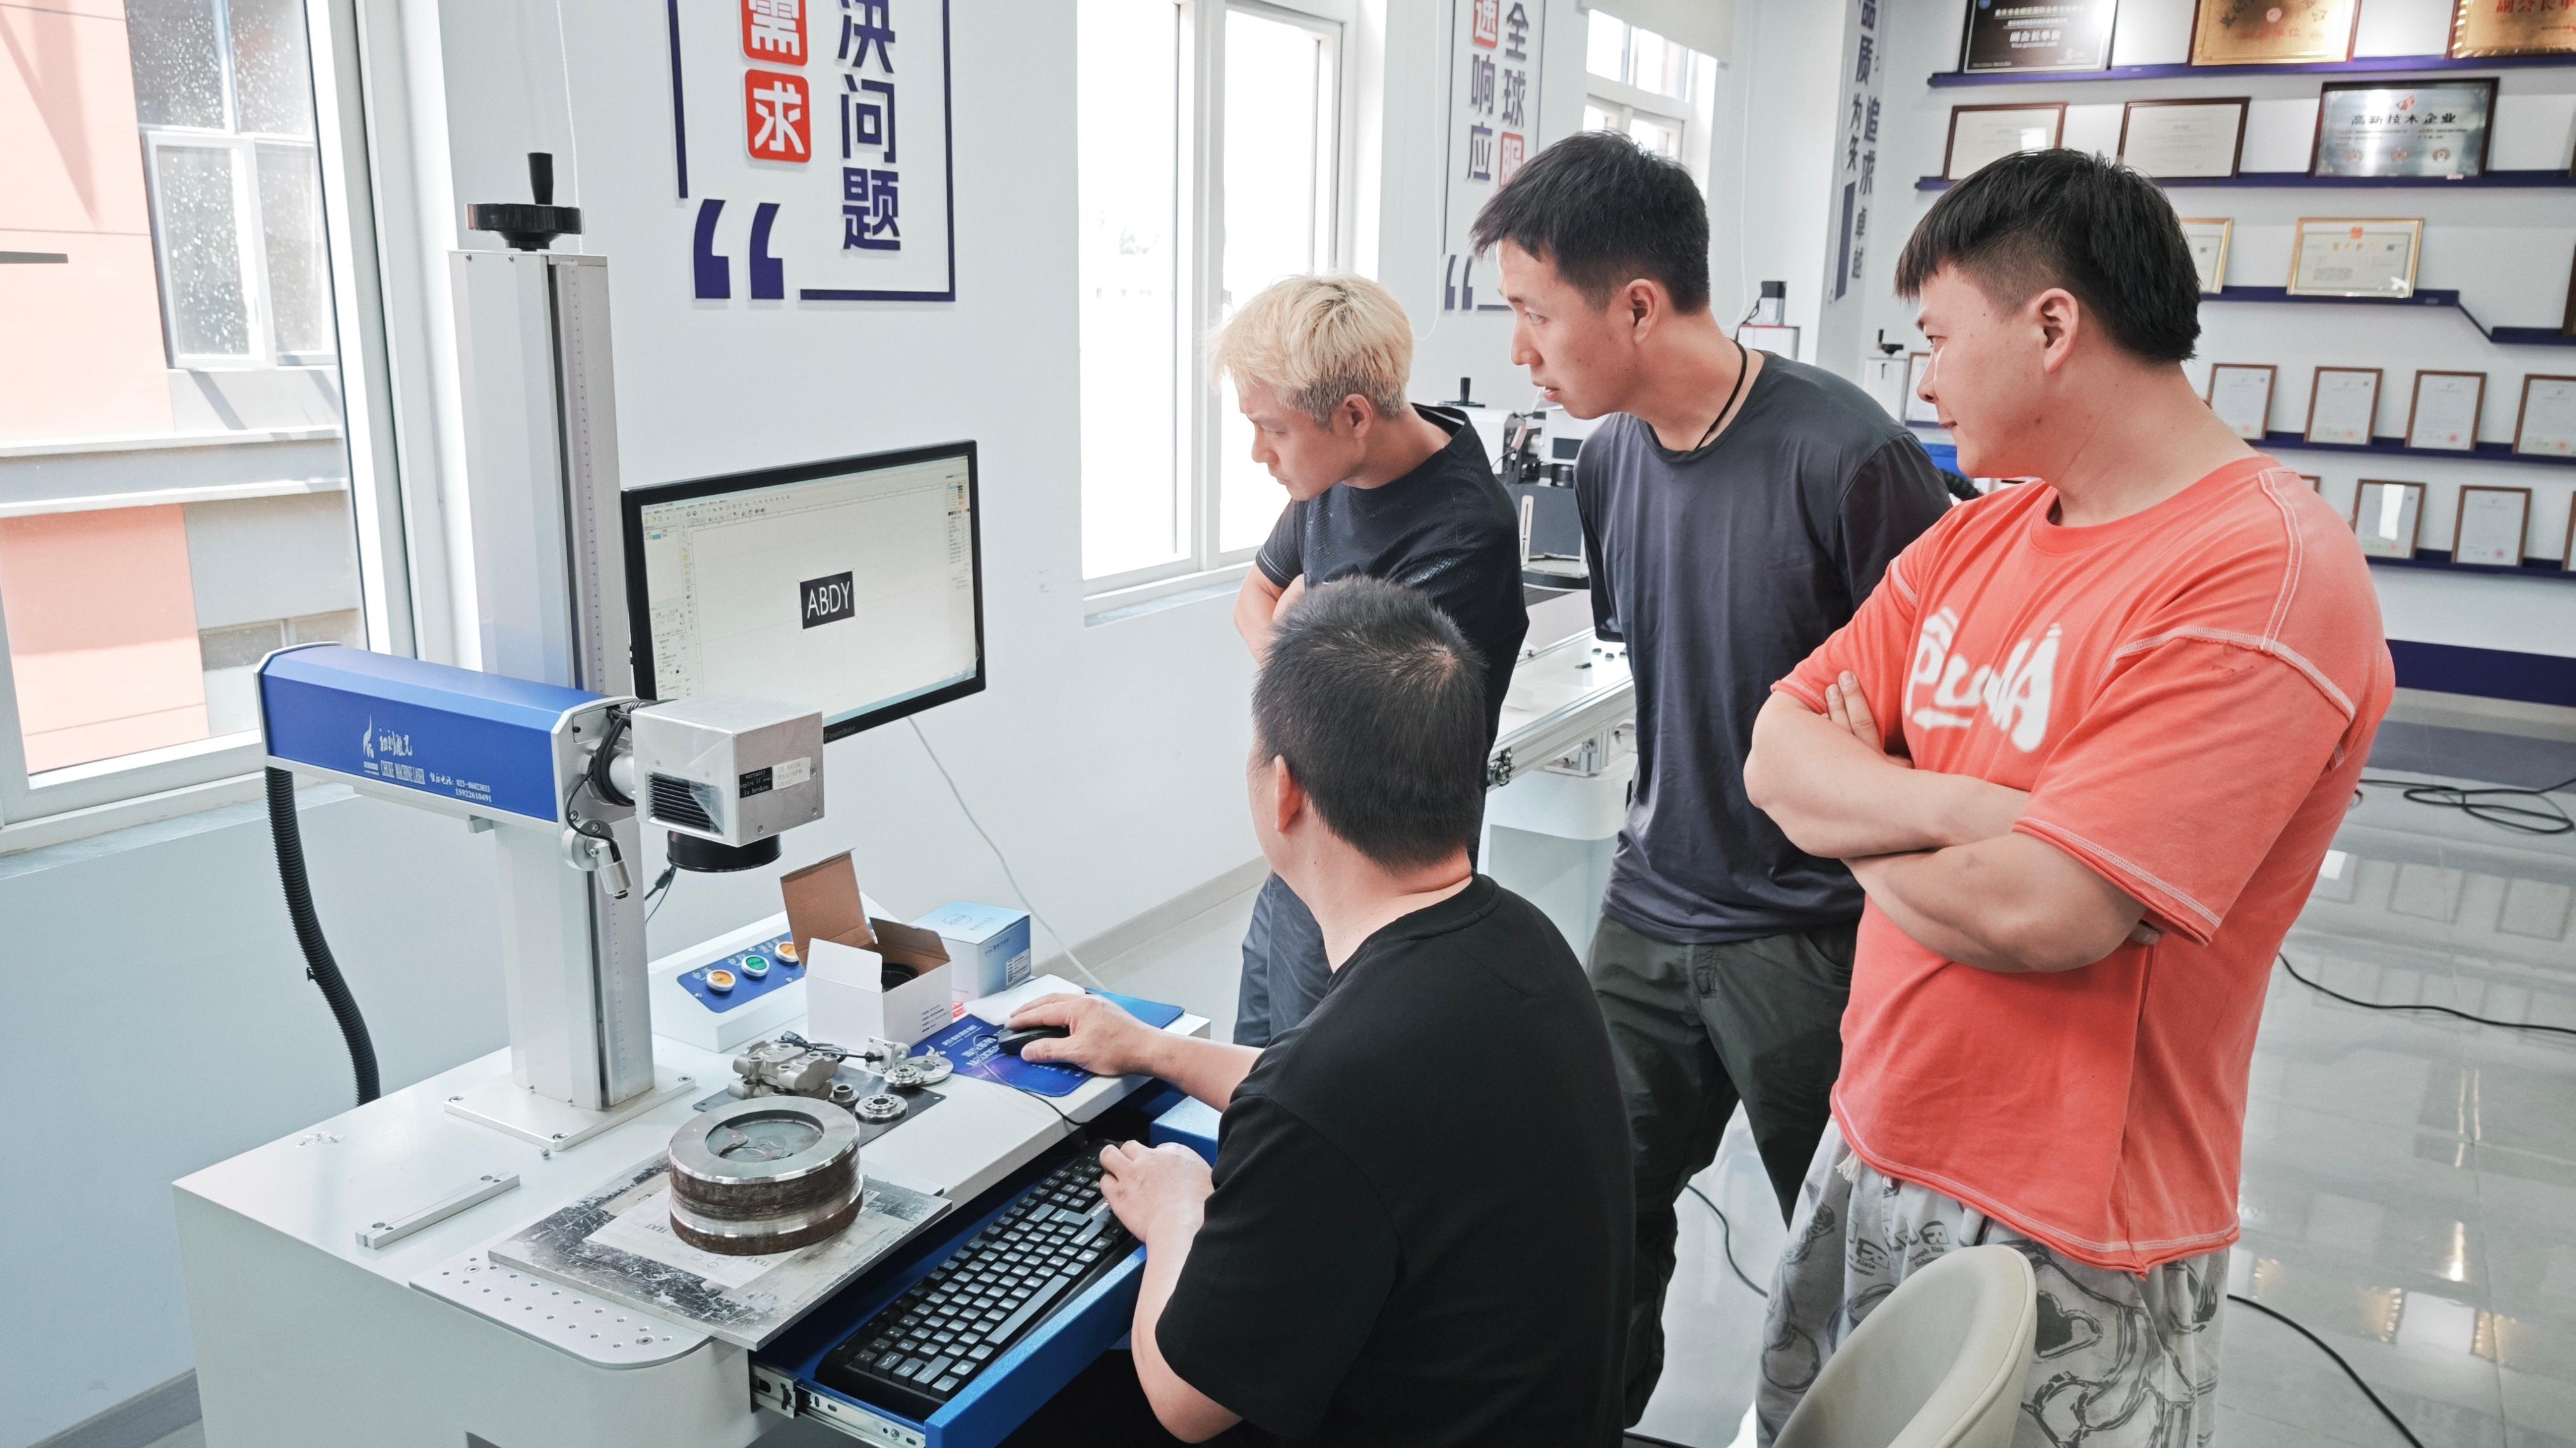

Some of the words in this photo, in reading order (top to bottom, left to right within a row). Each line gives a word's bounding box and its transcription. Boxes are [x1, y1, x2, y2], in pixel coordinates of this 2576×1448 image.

[837, 0, 901, 251] 决问题
[2351, 112, 2457, 125] 高新技术企业
[807, 581, 850, 619] ABDY
